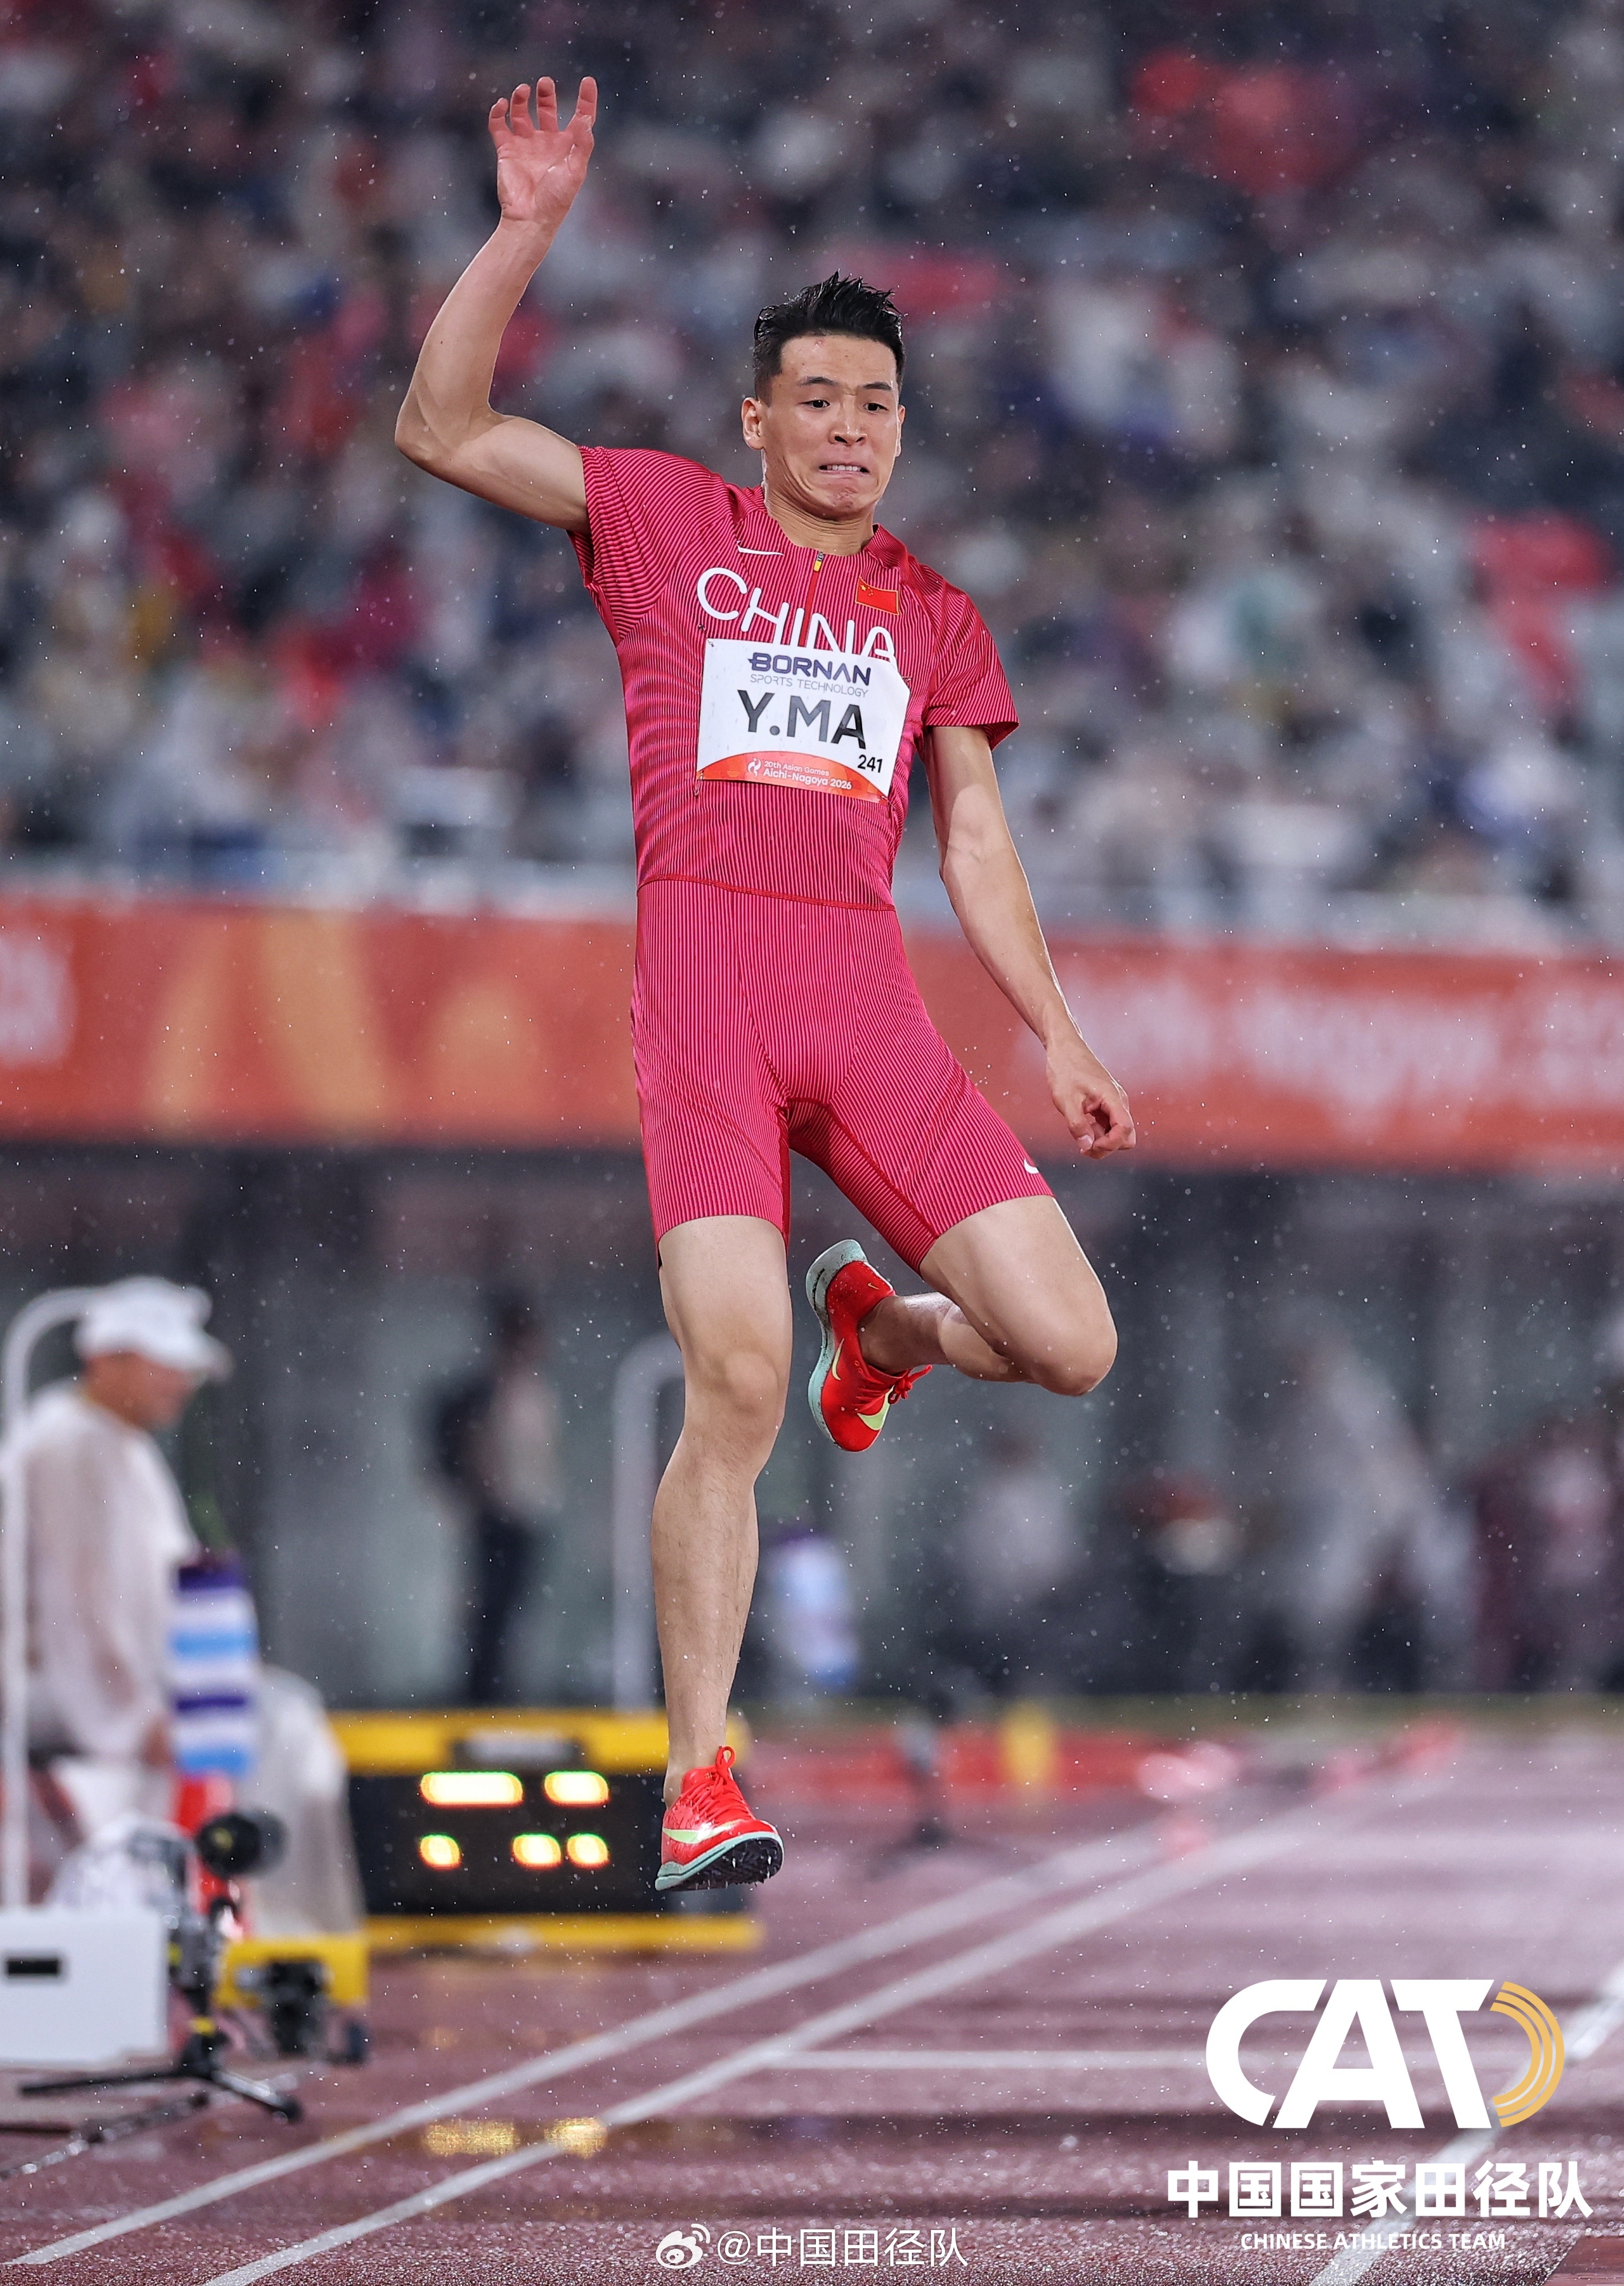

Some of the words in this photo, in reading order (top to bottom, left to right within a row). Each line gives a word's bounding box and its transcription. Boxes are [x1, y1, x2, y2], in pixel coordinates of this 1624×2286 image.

[697, 567, 898, 672] CHINA
[747, 652, 871, 686] BORNAN
[750, 674, 793, 687] SPORTS
[797, 678, 869, 698] TECHNOLOGY
[737, 689, 866, 750] Y.MA
[763, 761, 782, 770] 20th
[783, 763, 803, 773] Asian
[804, 766, 830, 777] Games
[857, 754, 883, 773] 241
[762, 769, 829, 786] Aichi-Nagoya
[830, 778, 853, 790] 2026
